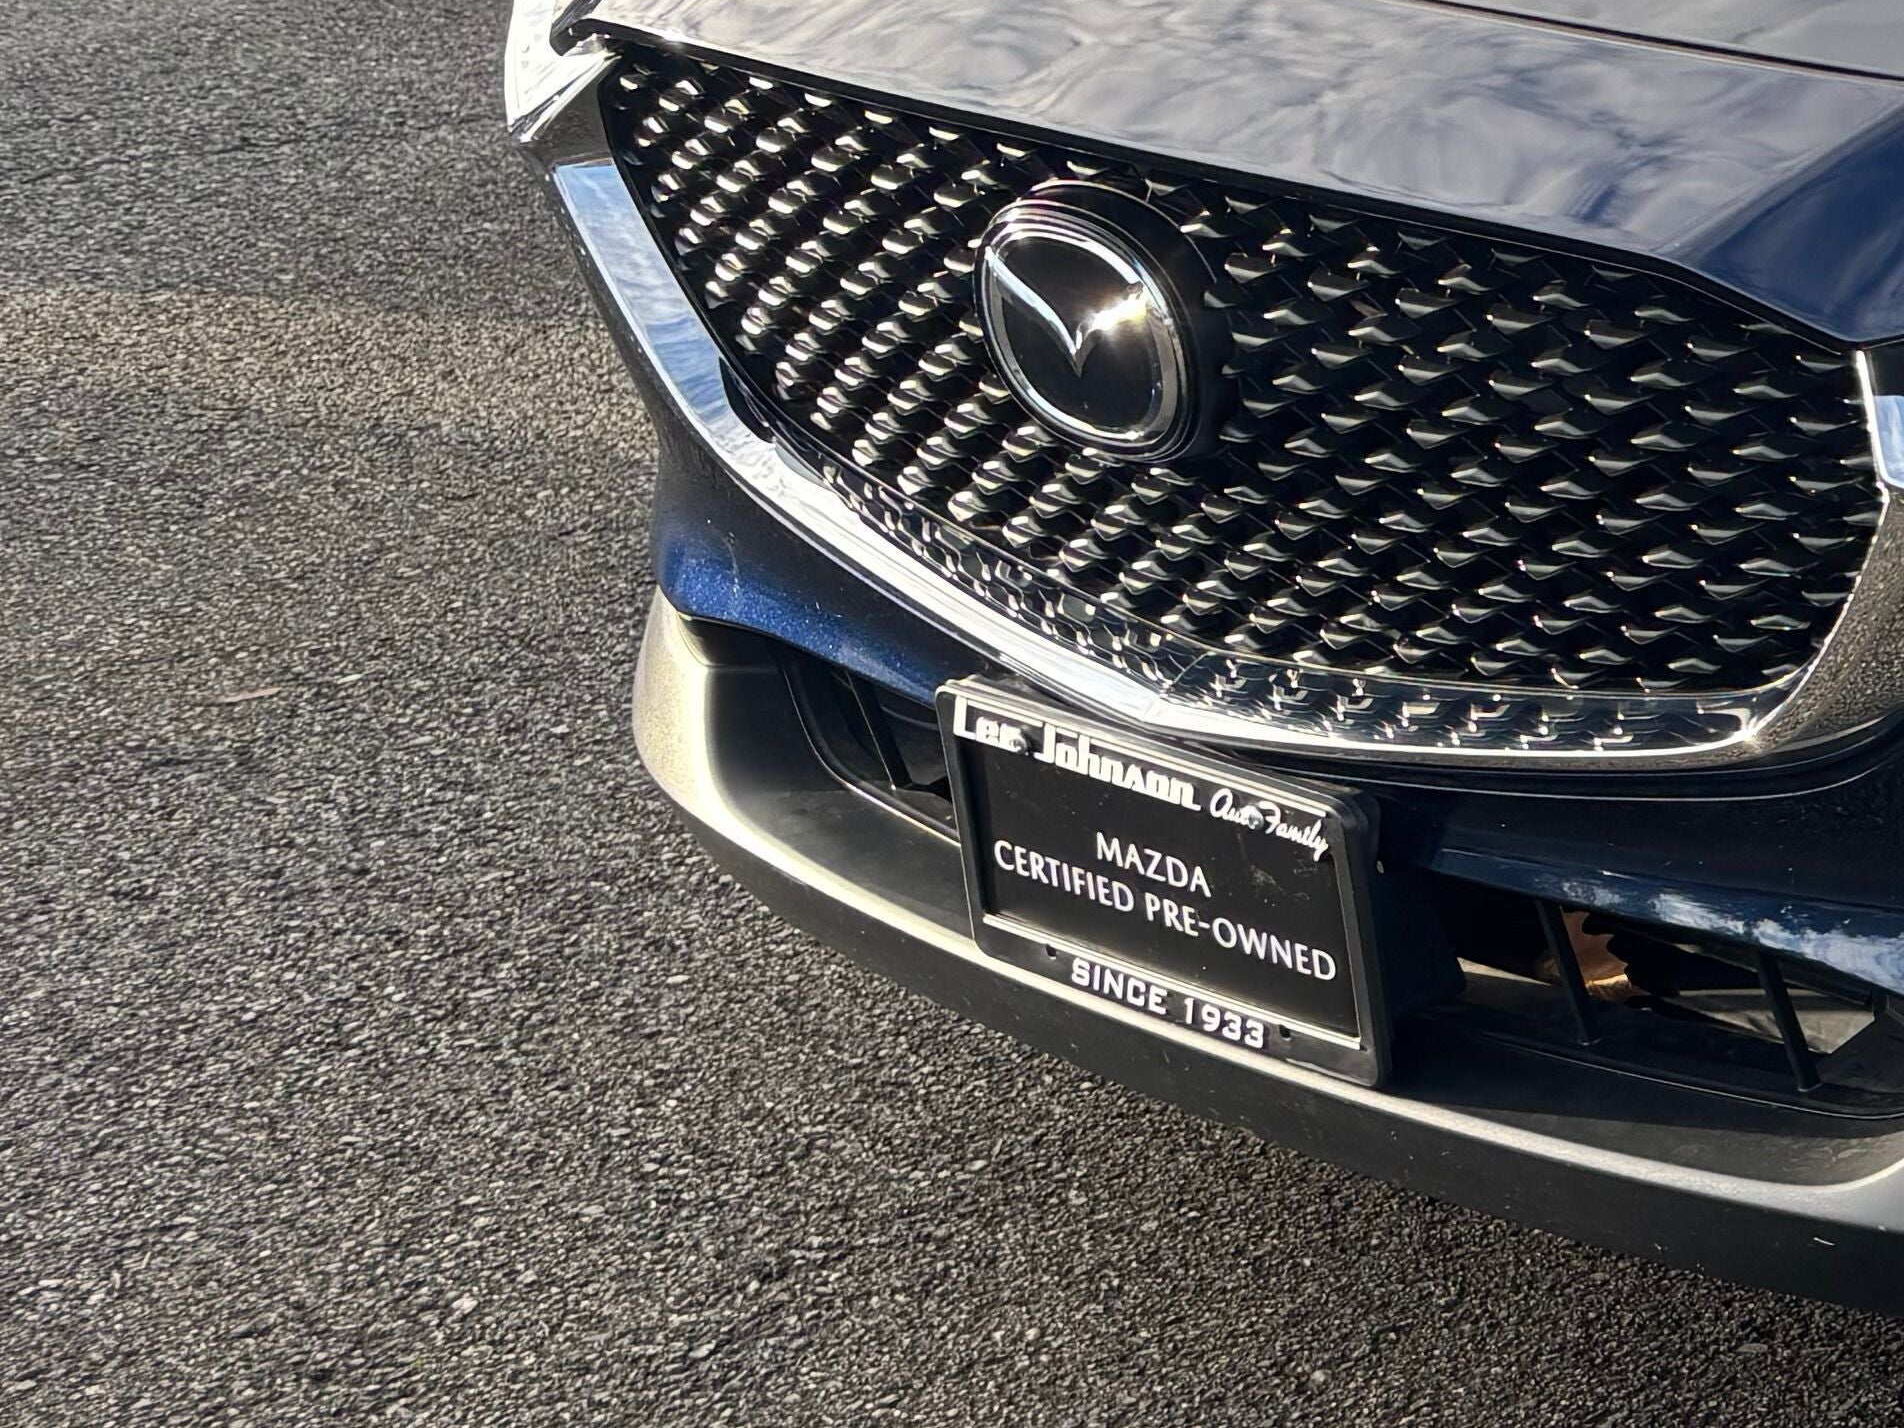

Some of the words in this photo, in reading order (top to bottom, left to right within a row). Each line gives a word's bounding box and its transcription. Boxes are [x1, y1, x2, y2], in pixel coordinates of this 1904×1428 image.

[1033, 722, 1202, 811] Johnson
[1209, 787, 1264, 829] Aut
[1258, 800, 1329, 862] Family
[993, 839, 1135, 913] CERTIFIED
[1144, 892, 1337, 982] PRE-OWNED
[1095, 831, 1212, 898] MAZDA
[1071, 957, 1169, 1016] SINCE
[1183, 997, 1265, 1050] 1933
